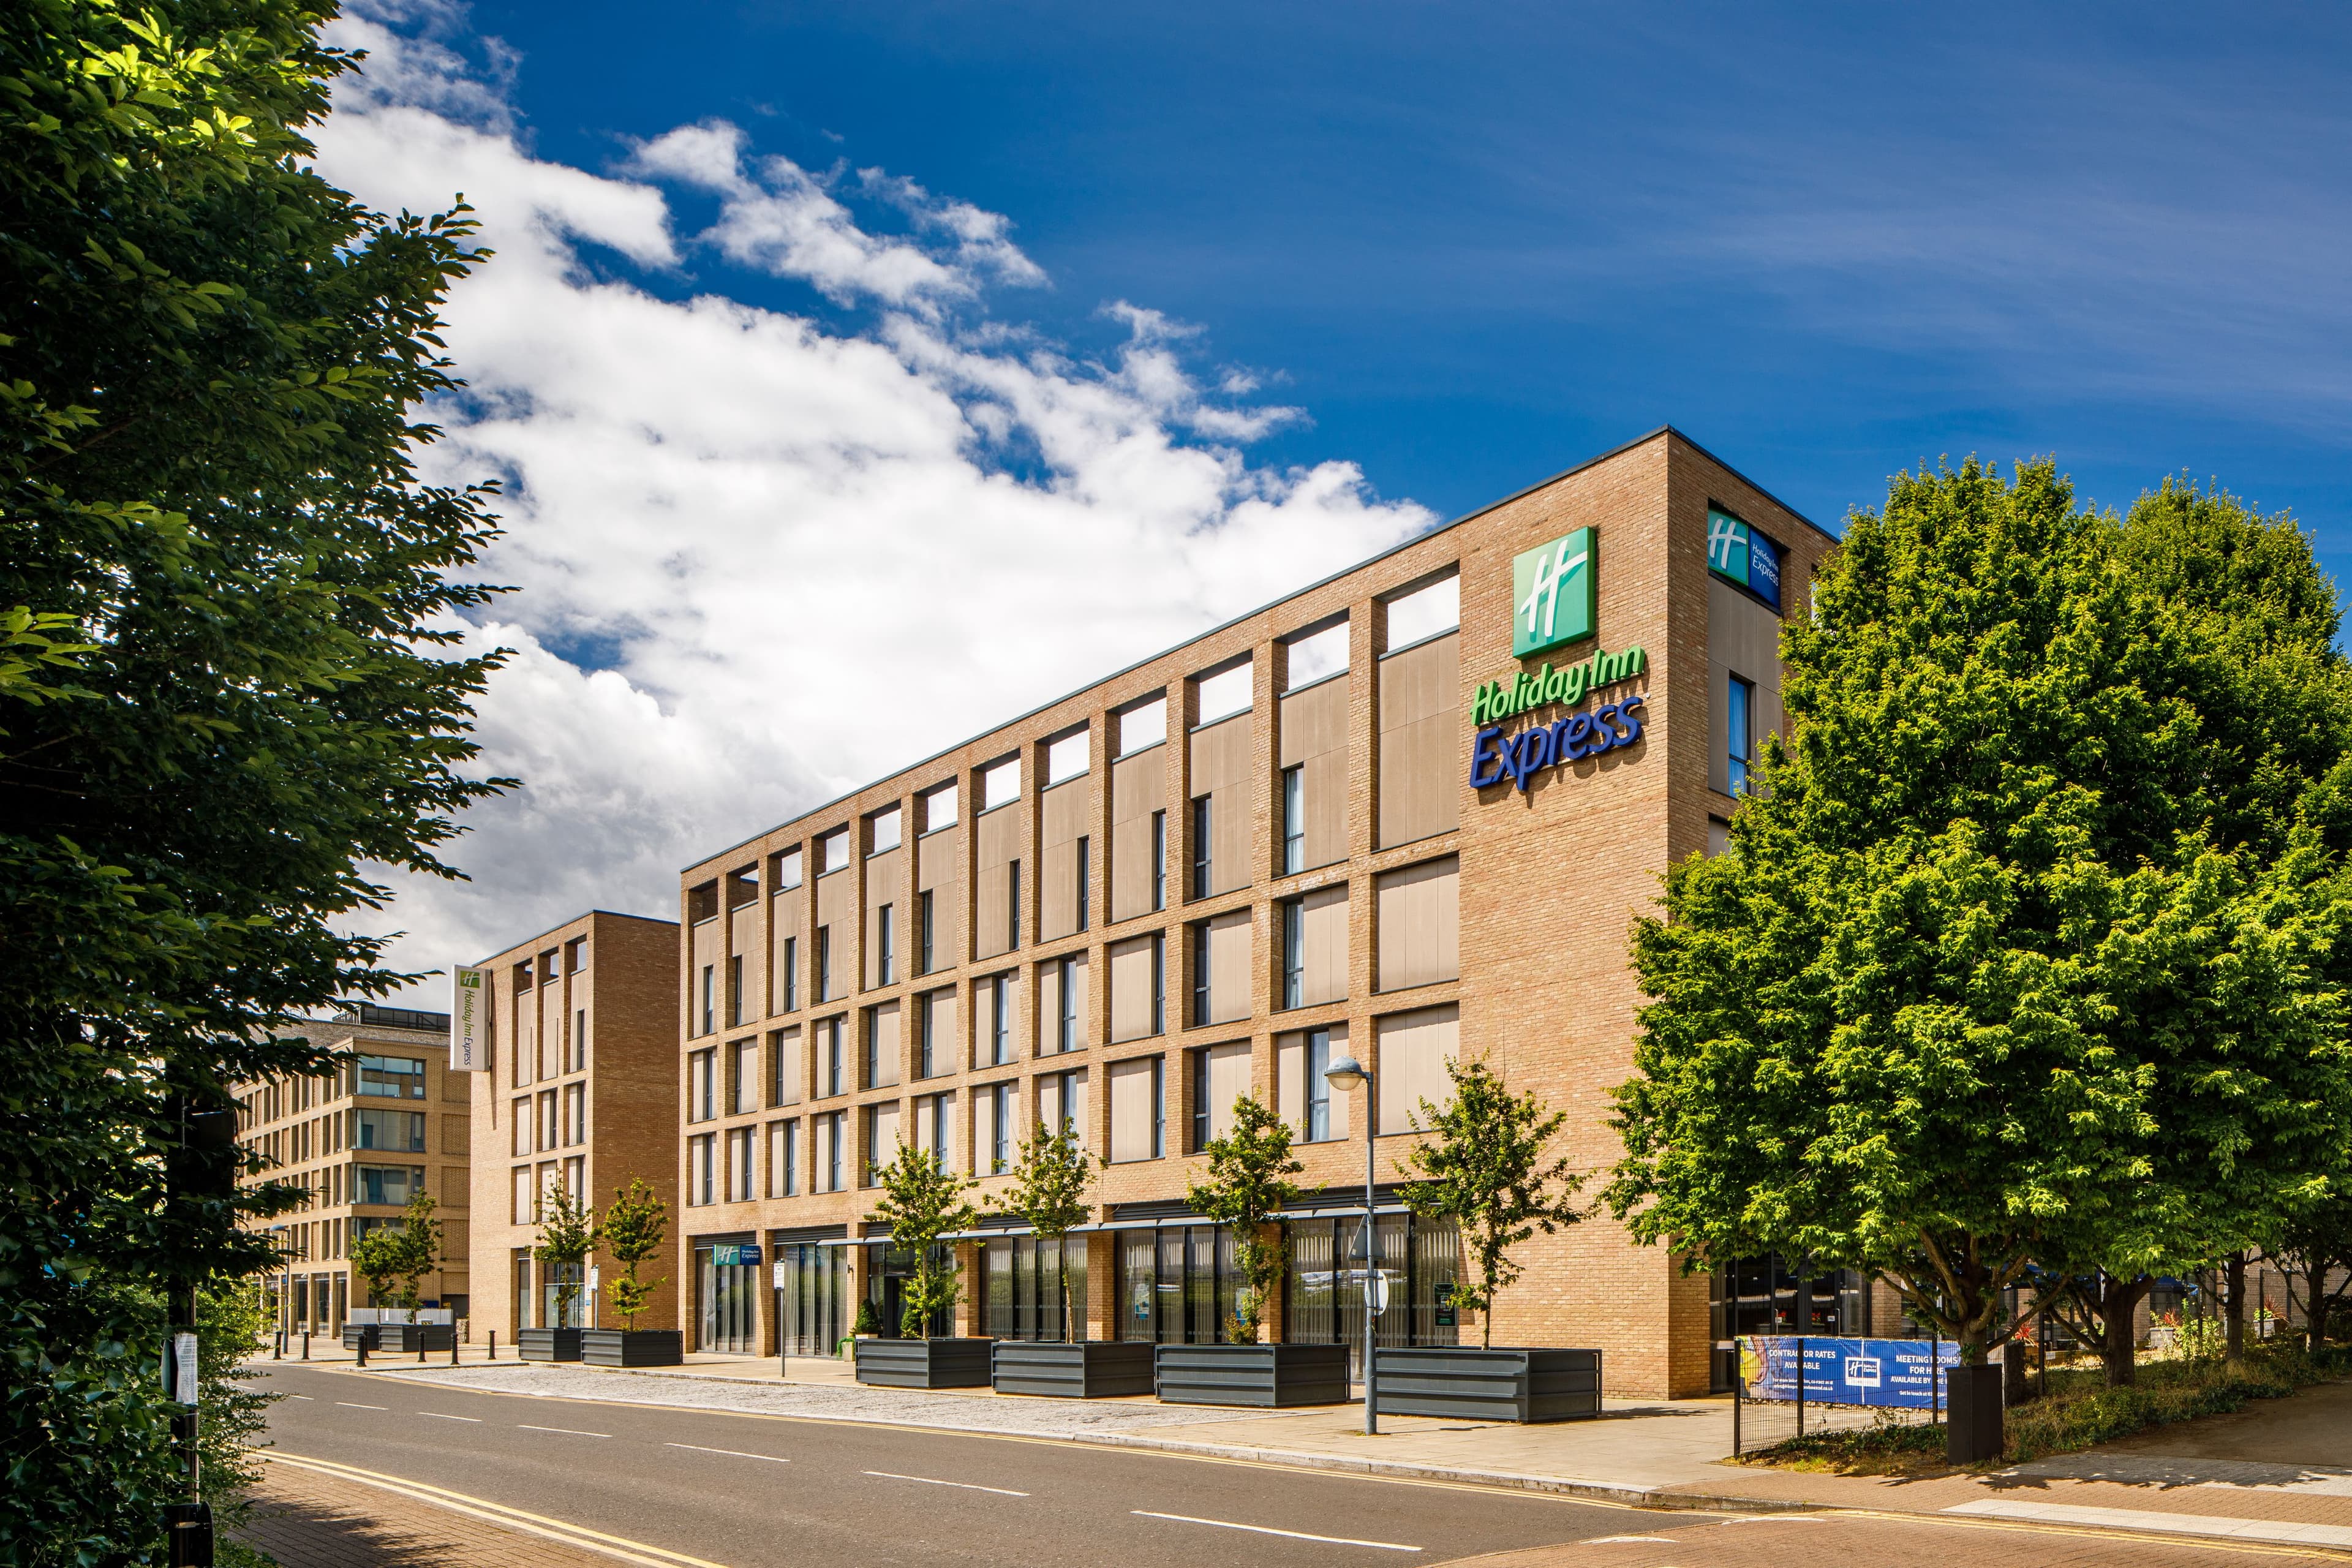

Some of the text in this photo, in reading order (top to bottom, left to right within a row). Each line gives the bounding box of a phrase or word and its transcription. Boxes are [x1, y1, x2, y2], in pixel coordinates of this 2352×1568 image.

[1752, 543, 1772, 567] Holiday
[1752, 555, 1779, 586] Express
[1469, 645, 1646, 726] Holiday Inn
[1470, 696, 1643, 791] Express
[462, 989, 475, 1066] Holiday Inn Express
[1896, 1355, 1929, 1363] MEETING
